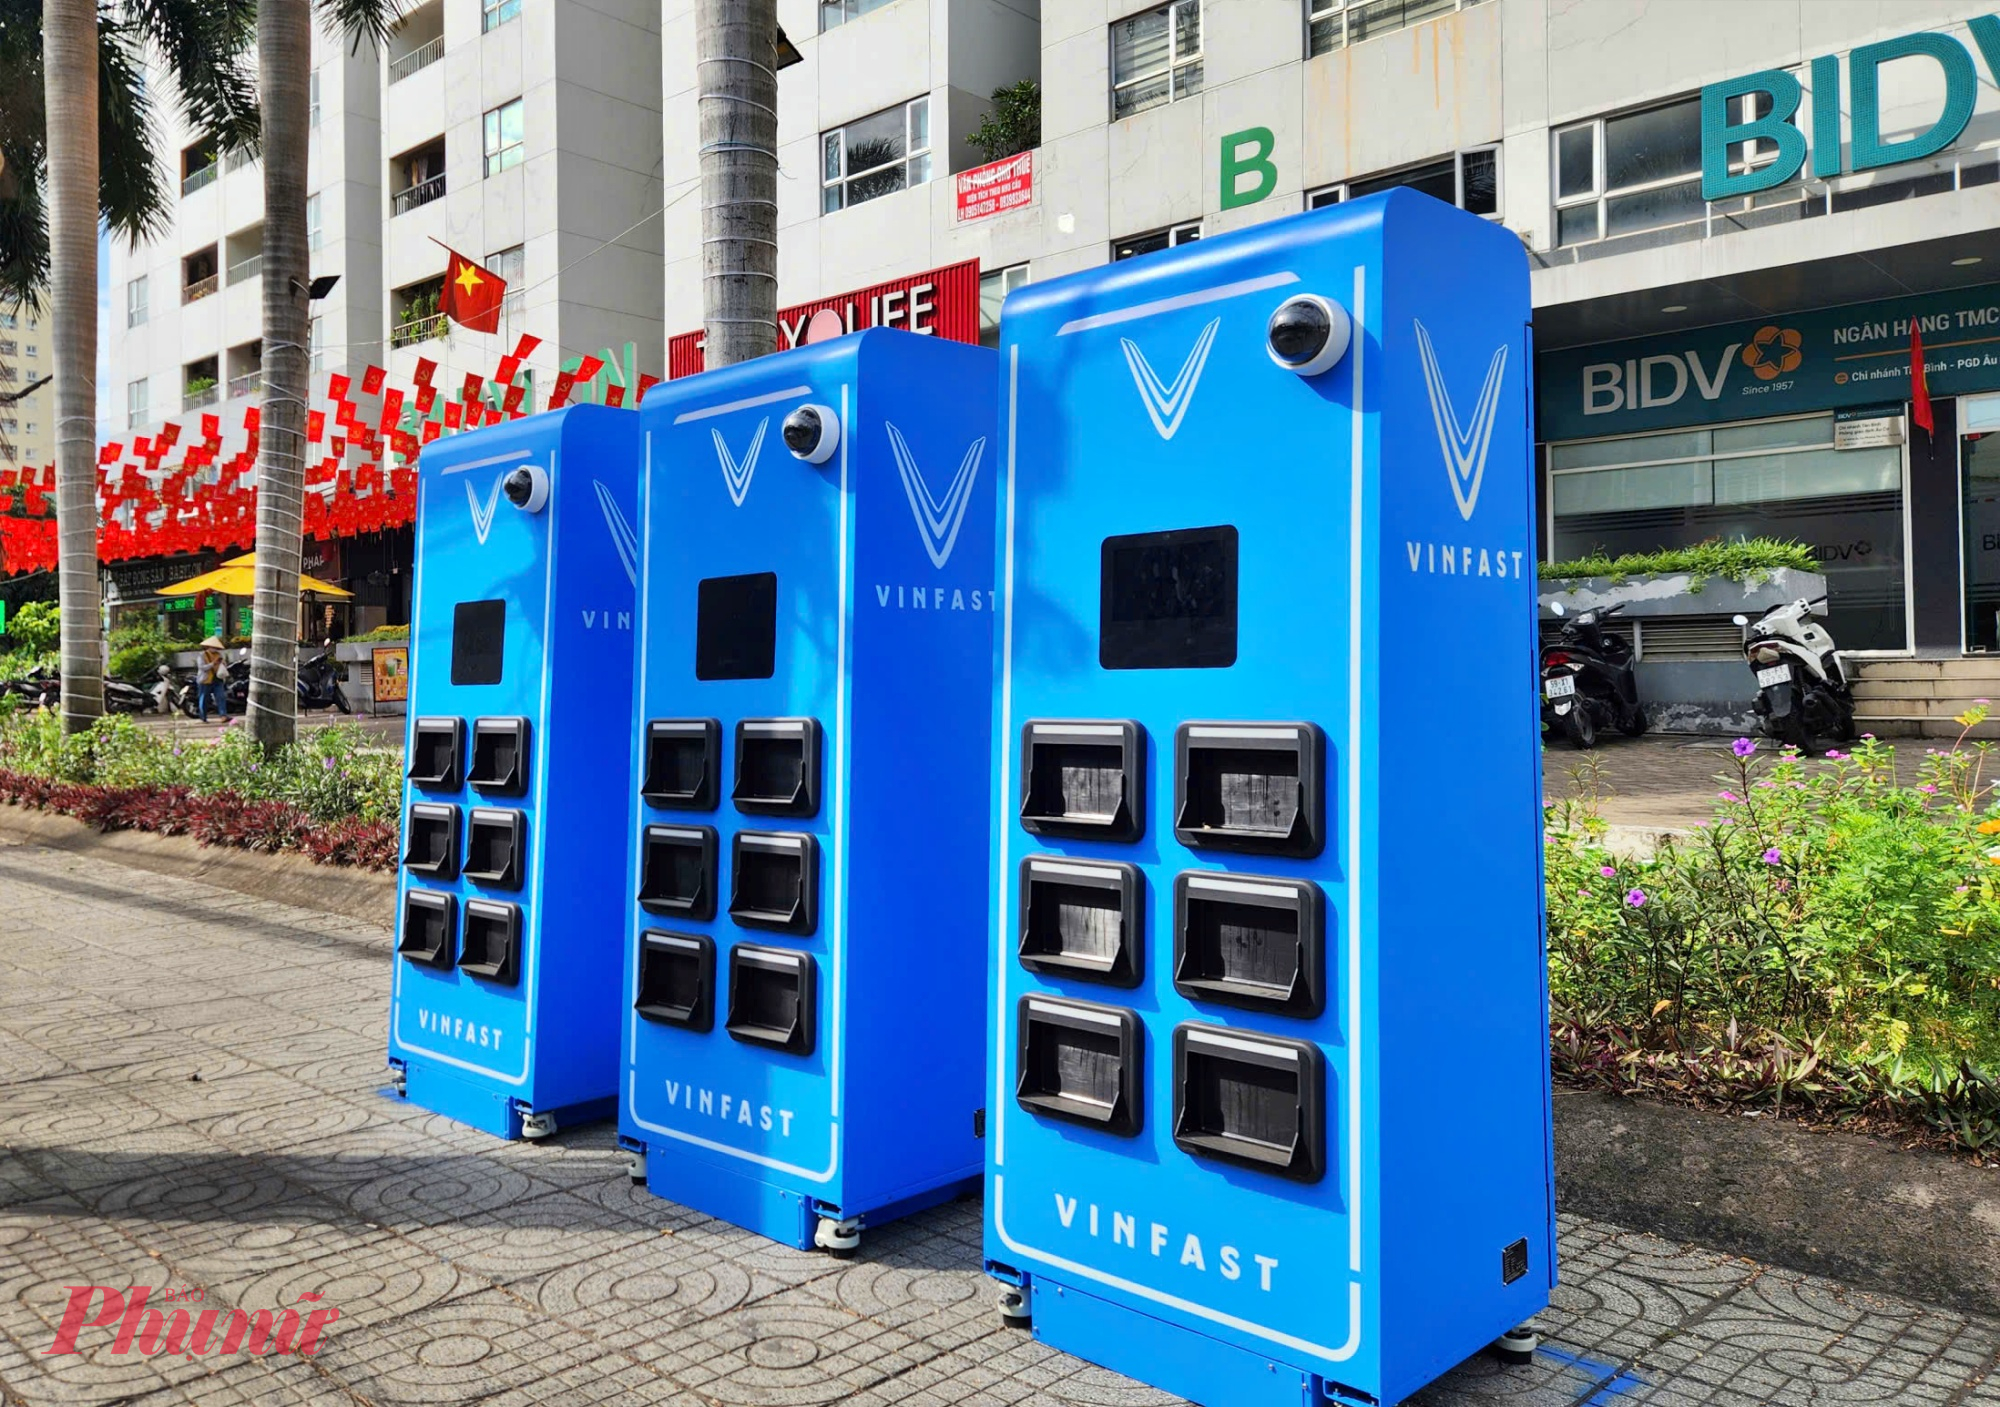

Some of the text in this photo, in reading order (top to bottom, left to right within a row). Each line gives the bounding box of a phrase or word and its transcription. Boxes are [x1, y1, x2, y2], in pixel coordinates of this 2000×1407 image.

[1220, 126, 1278, 212] B
[1834, 321, 1887, 344] NGÂN
[1583, 343, 1742, 415] BIDV
[1851, 371, 1868, 381] Chi
[1870, 367, 1901, 379] nhánh
[1957, 357, 1980, 369] PGD
[1983, 353, 1998, 366] Âu
[1742, 380, 1794, 395] Since 1957
[1407, 541, 1523, 579] VINFAST
[875, 584, 995, 611] VINFAST
[419, 1009, 503, 1051] VINFAST
[665, 1080, 794, 1137] VINFAST
[1055, 1193, 1279, 1291] VINFAST
